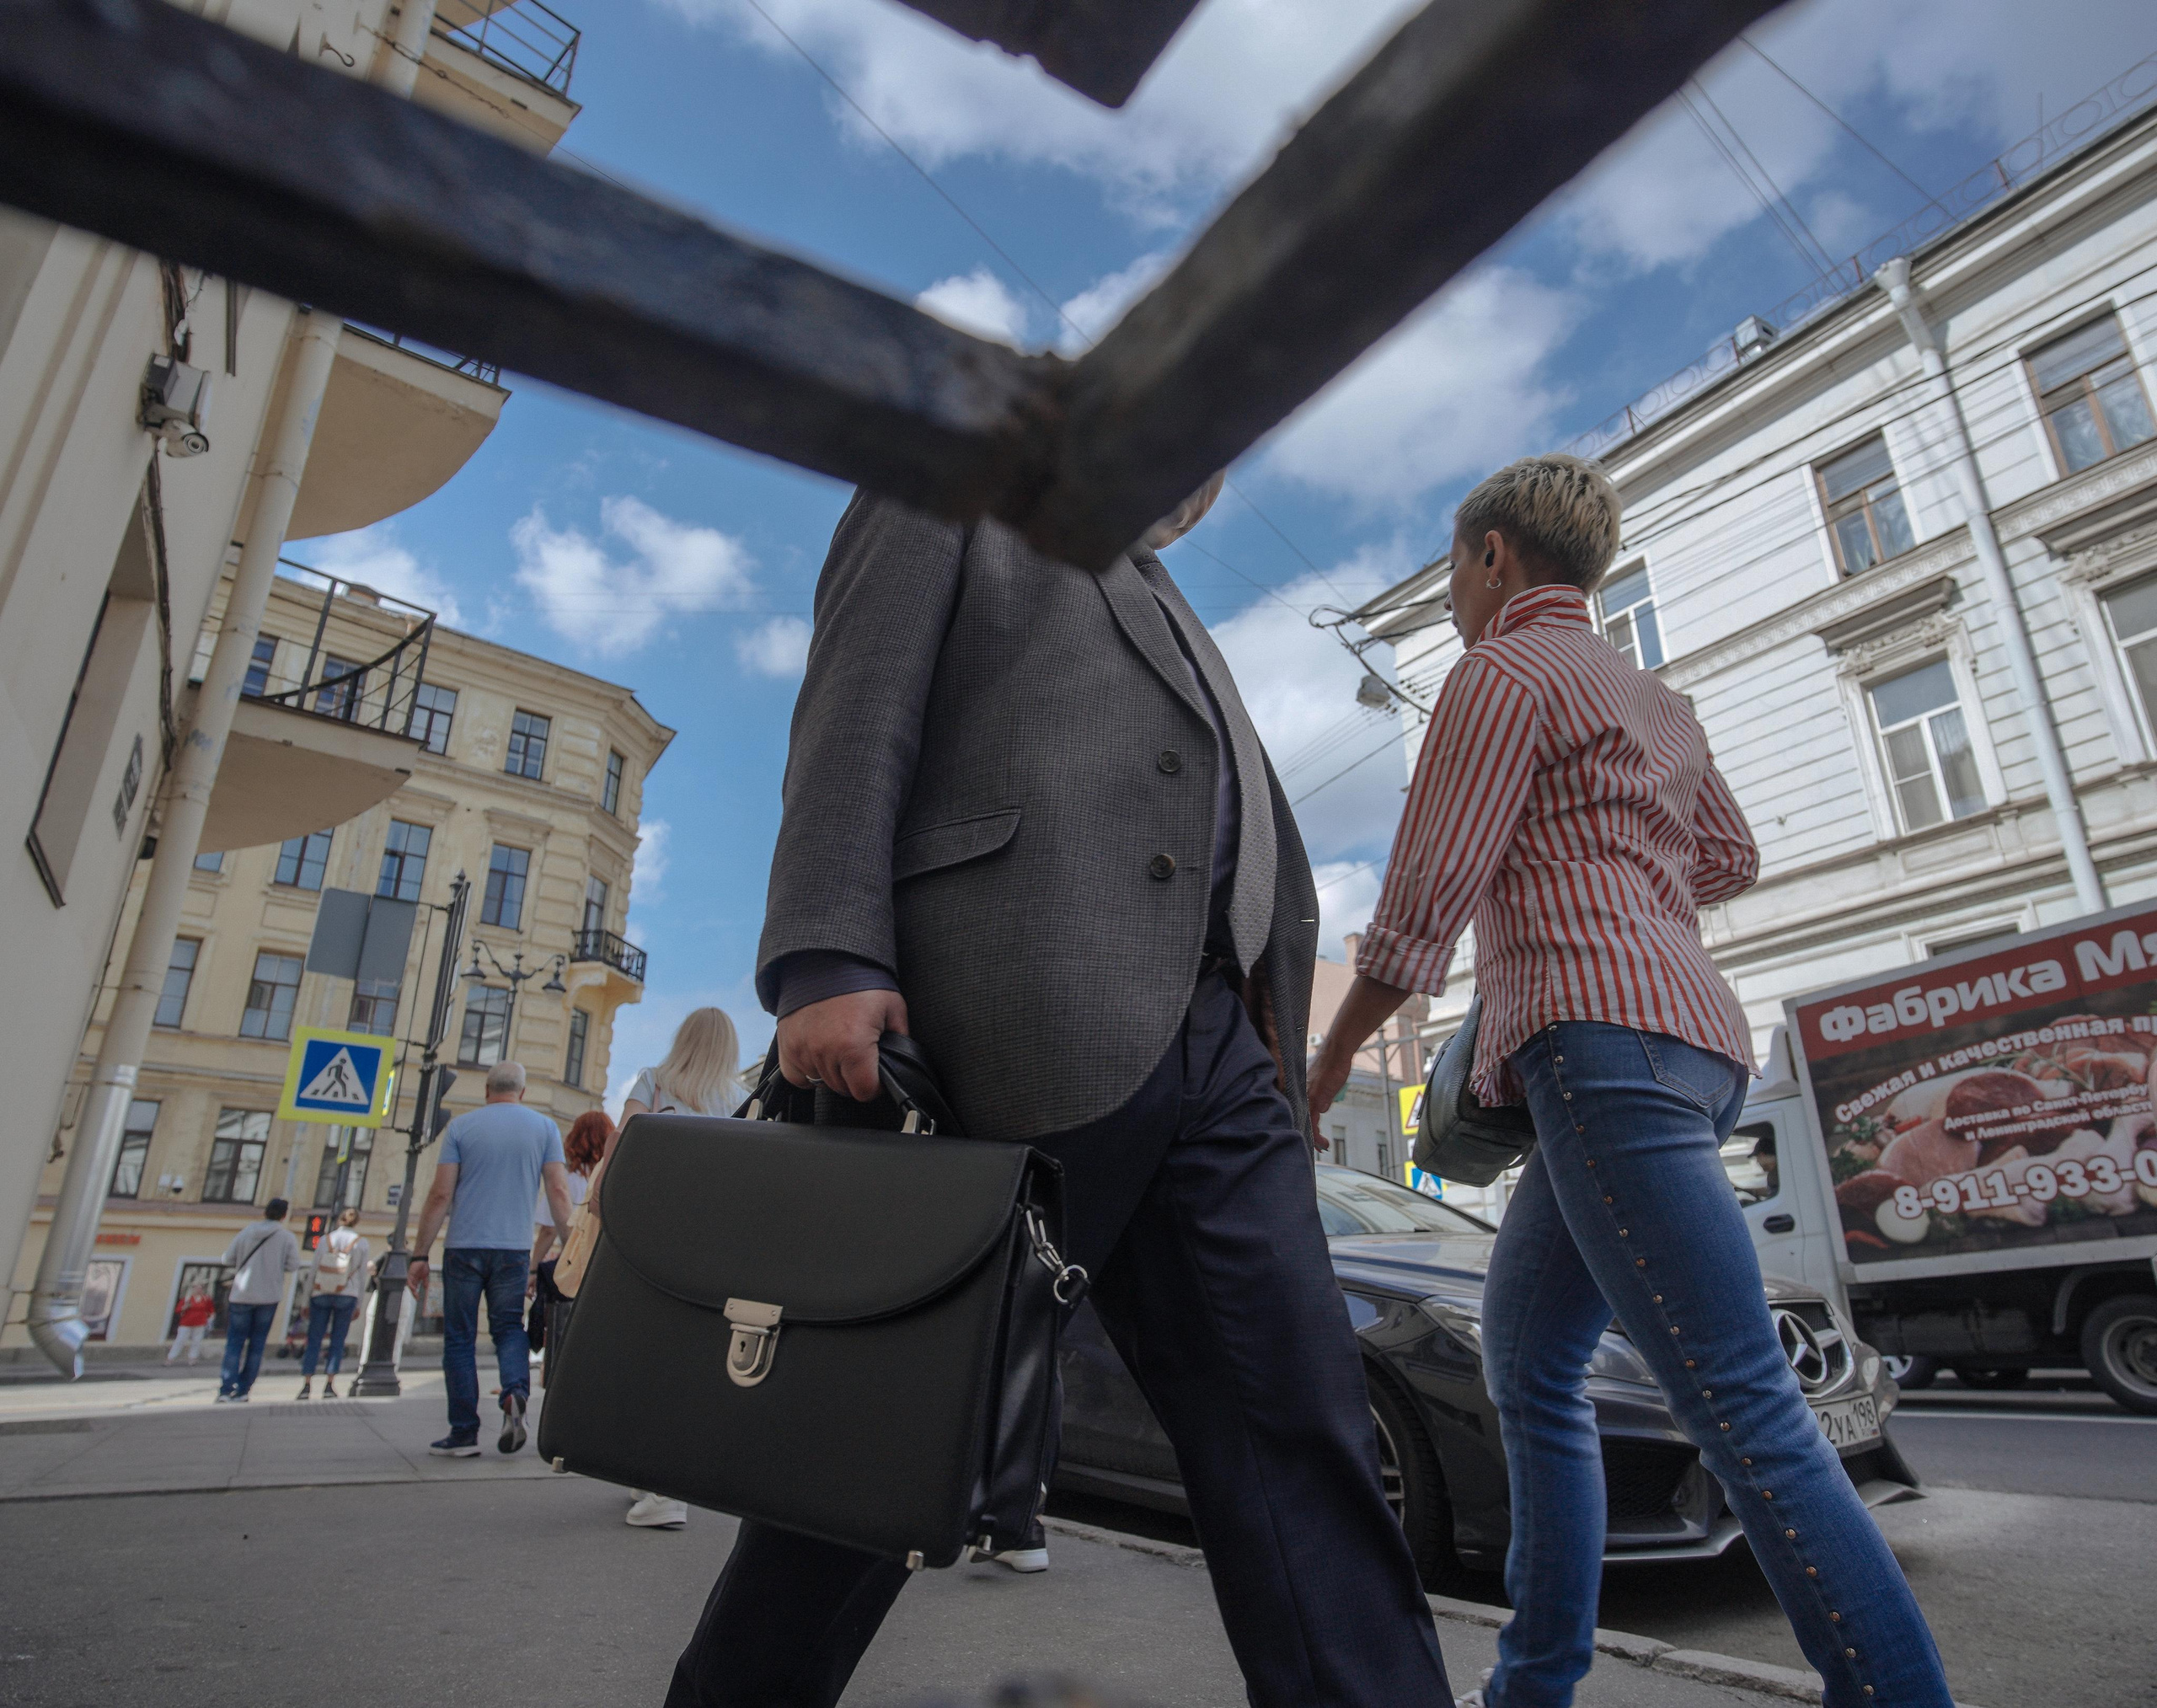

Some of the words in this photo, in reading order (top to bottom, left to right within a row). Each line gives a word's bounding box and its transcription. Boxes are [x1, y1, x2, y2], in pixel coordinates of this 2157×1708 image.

[1820, 959, 2067, 1043] Фабрика
[1834, 1068, 1918, 1122] Свежая
[1919, 1062, 1936, 1079] и
[1938, 1017, 2125, 1072] качественная
[1944, 1108, 2010, 1131] Доставка
[2011, 1105, 2031, 1116] по
[1965, 1131, 1976, 1141] и
[1977, 1108, 2091, 1139] Ленинградской
[1895, 1149, 2157, 1219] 8-911-933-0
